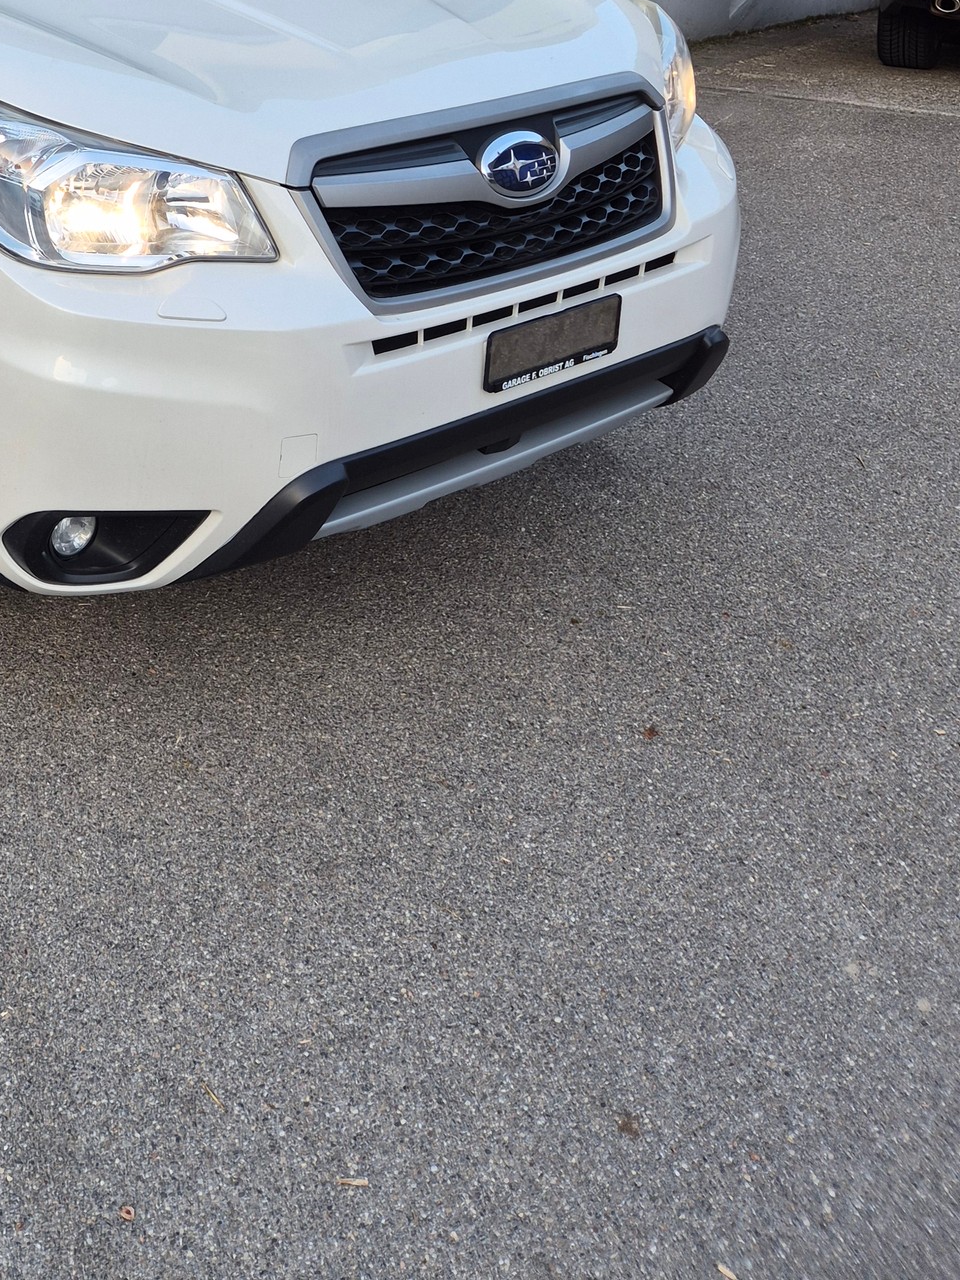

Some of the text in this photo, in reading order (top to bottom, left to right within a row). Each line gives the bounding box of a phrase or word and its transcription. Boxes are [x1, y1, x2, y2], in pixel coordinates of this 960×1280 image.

[502, 373, 531, 390] GARAGE
[538, 362, 564, 377] OBRIST
[564, 358, 575, 369] AG
